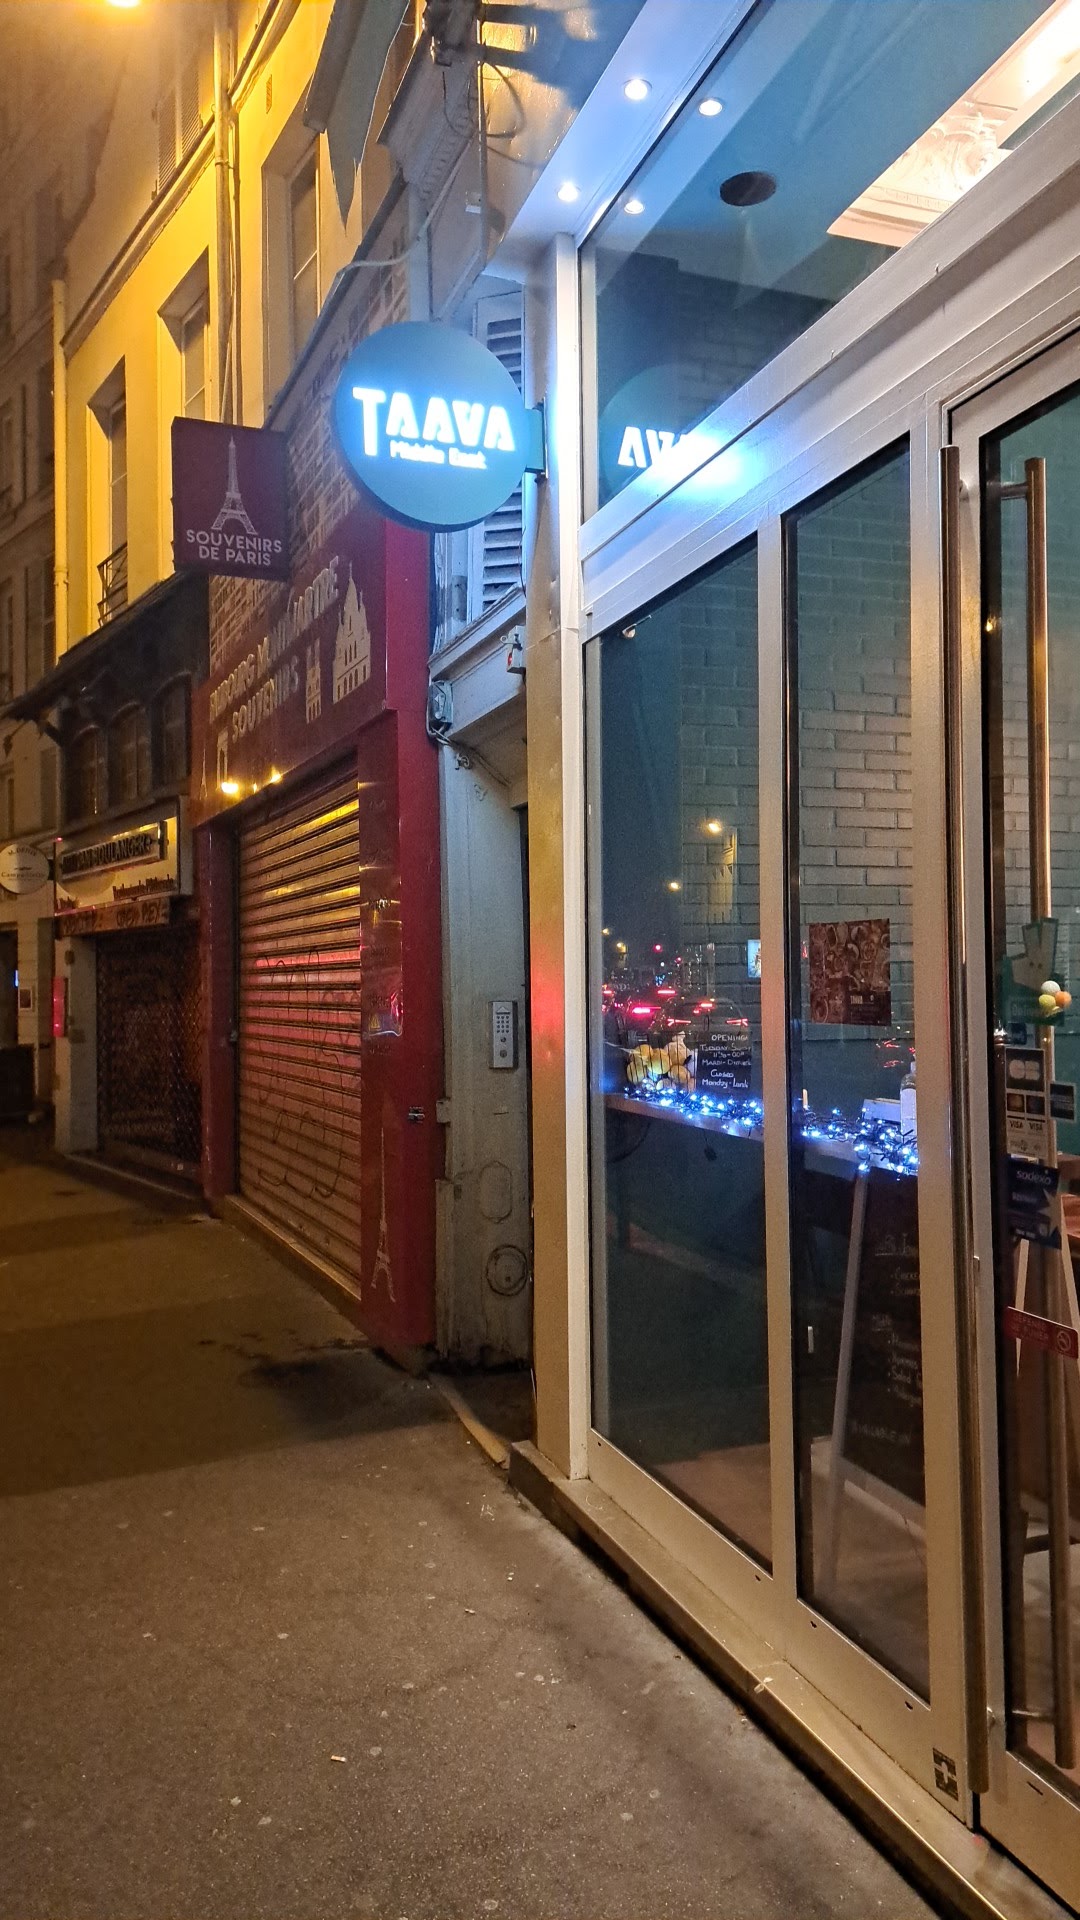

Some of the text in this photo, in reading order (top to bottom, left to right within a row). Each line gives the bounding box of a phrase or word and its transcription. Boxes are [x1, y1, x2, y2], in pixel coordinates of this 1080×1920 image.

[352, 386, 515, 457] TAAVA
[448, 447, 487, 470] East
[186, 528, 282, 553] SOUVENIRS
[199, 545, 271, 567] DE PARIS
[232, 655, 299, 744] SOUVENIRS
[1009, 1120, 1024, 1129] VISA
[1029, 1122, 1043, 1131] VISA
[1016, 1169, 1052, 1186] sodexo
